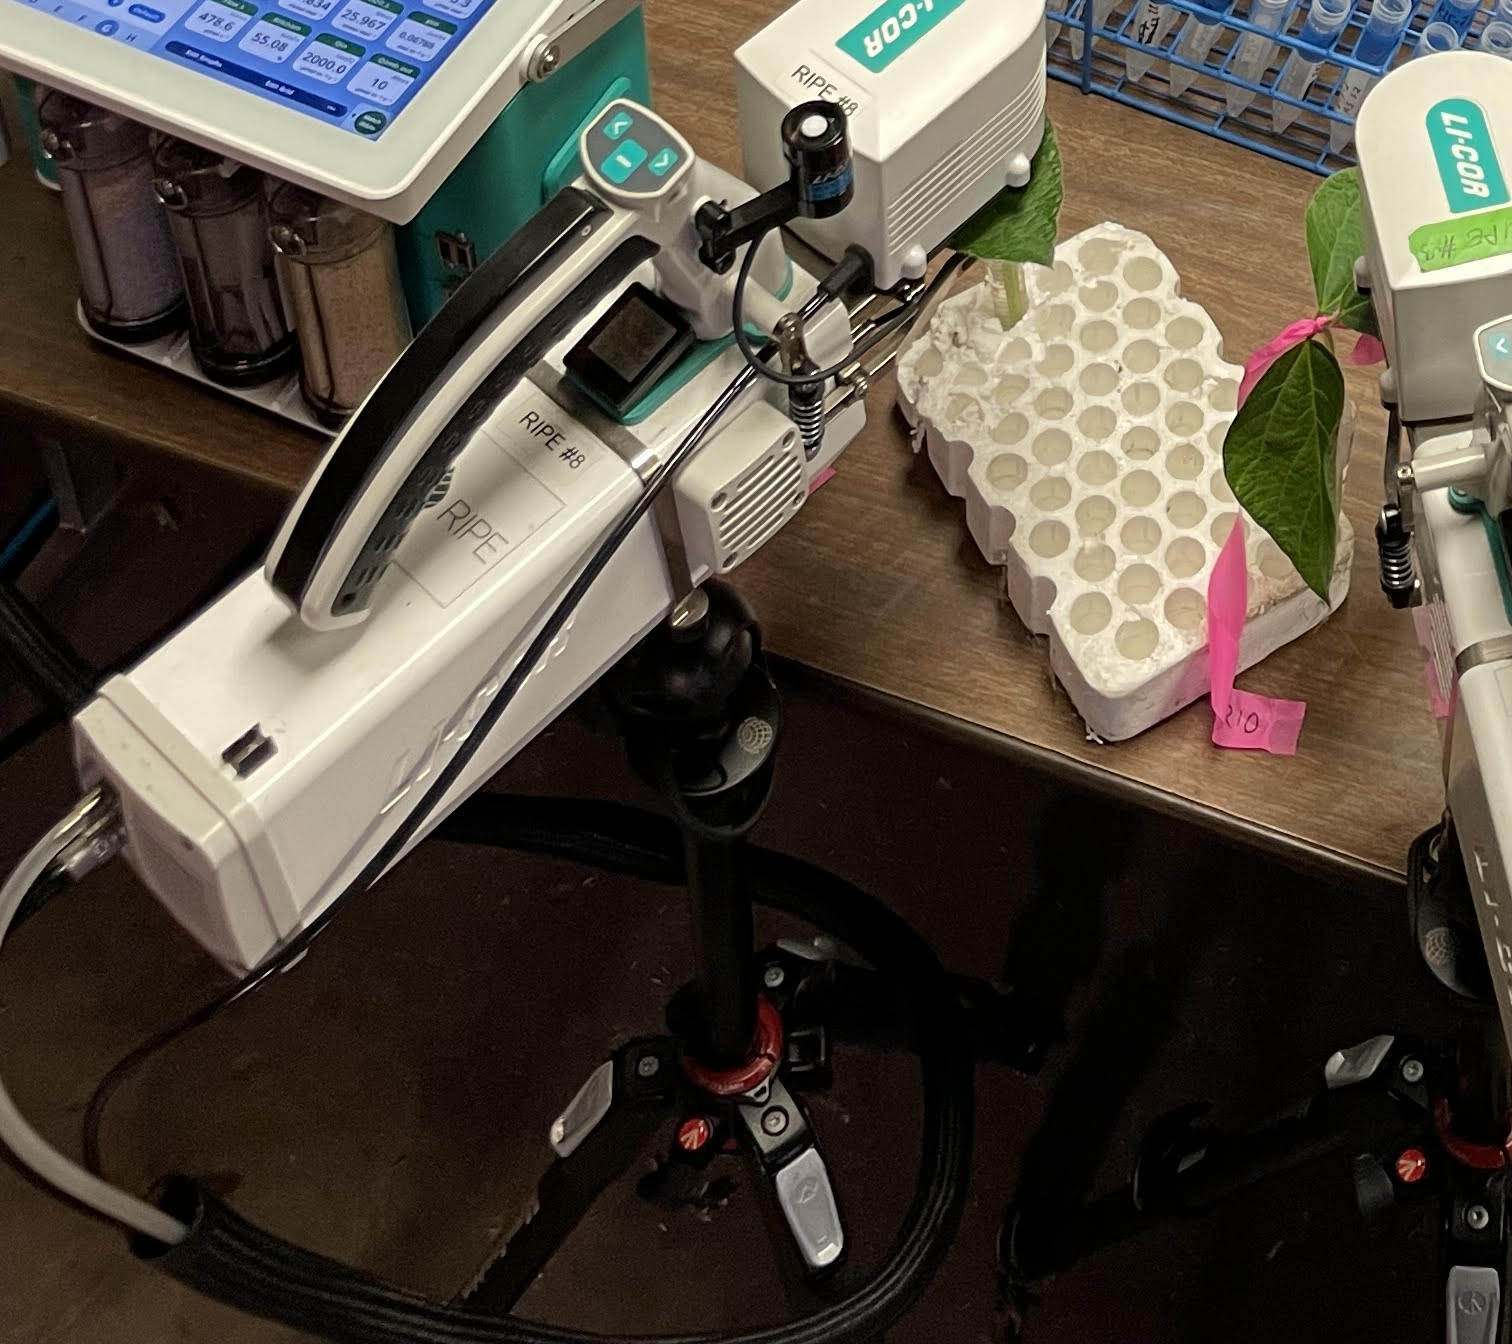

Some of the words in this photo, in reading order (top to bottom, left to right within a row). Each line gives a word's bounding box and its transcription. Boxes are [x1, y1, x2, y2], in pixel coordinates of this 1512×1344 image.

[198, 10, 234, 33] 478.6
[250, 30, 289, 54] 55.08
[302, 50, 348, 75] 2000.0
[370, 76, 389, 91] 10
[339, 8, 387, 32] 25.967
[791, 64, 838, 102] RIPE
[838, 94, 860, 118] #8
[1440, 111, 1490, 199] LI-COR
[518, 410, 567, 451] RIPE
[558, 446, 587, 470] #8
[437, 499, 510, 565] RIPE
